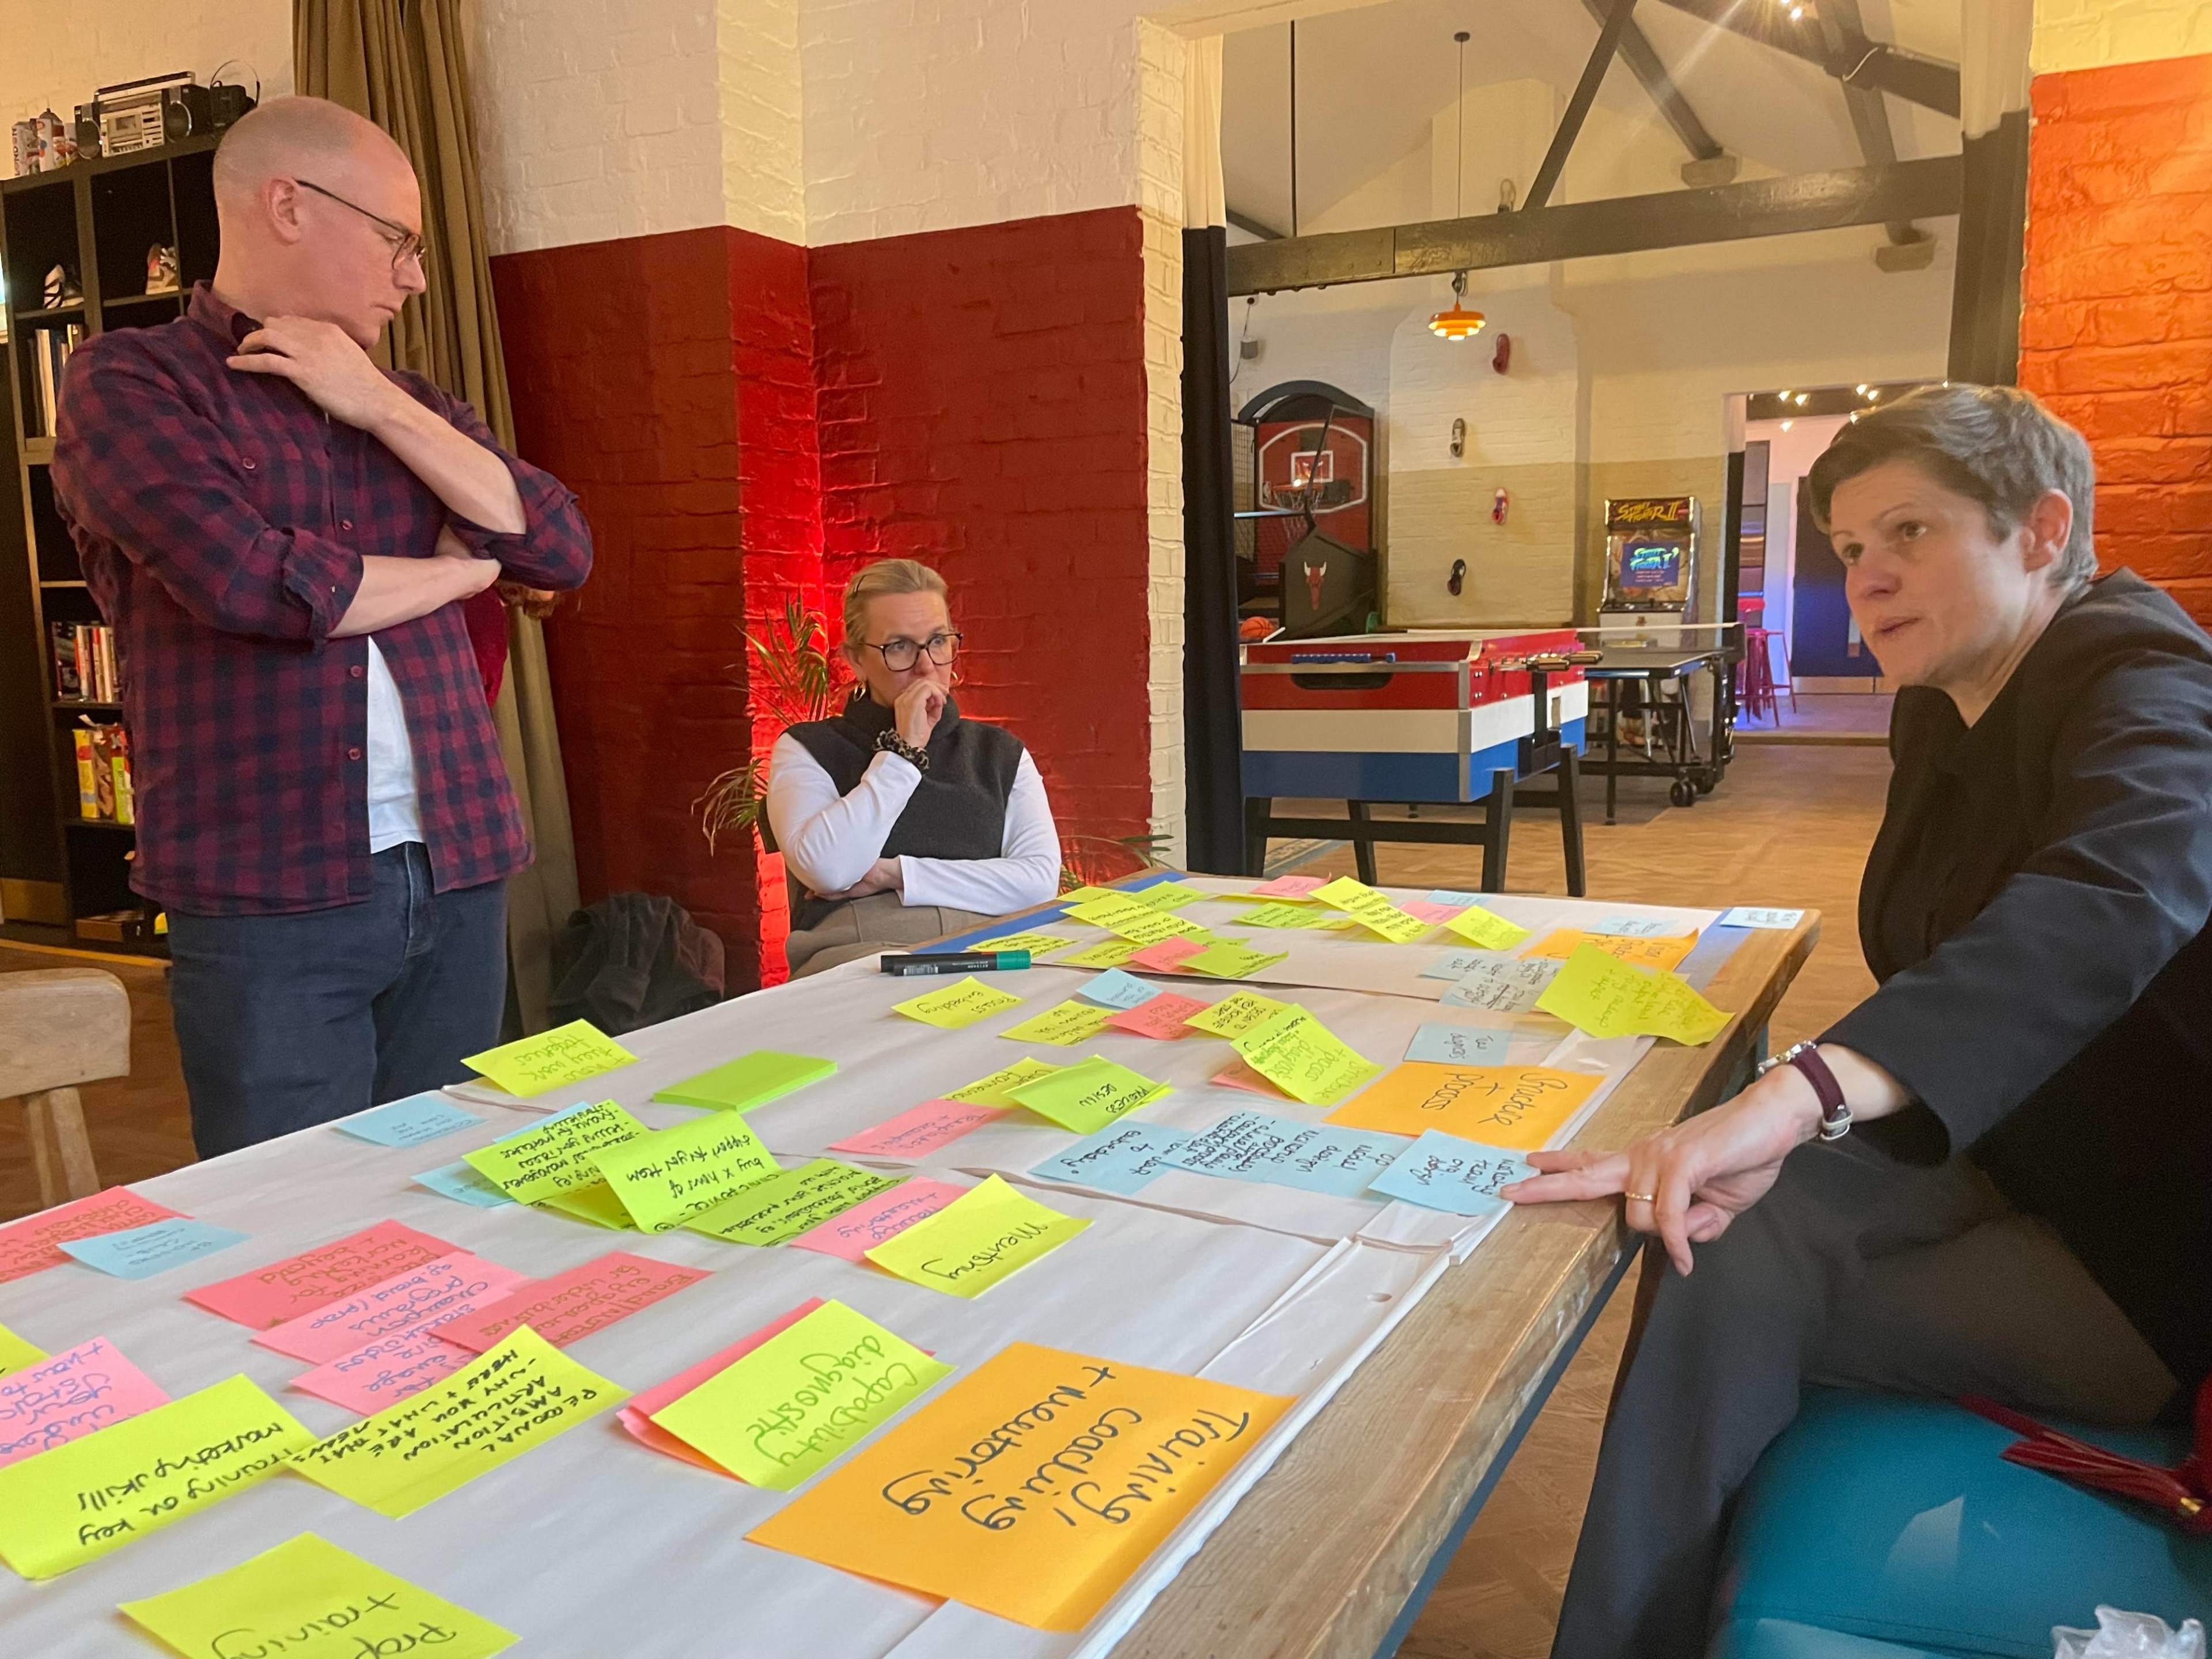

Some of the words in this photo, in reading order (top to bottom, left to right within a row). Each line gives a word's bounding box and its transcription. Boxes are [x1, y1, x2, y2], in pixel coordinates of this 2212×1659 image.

[466, 1349, 518, 1389] HERE
[746, 1335, 884, 1436] diagnostic
[373, 1401, 438, 1438] WHAT
[403, 1376, 546, 1461] ARTICULATION
[432, 1399, 476, 1423] YOU
[453, 1386, 562, 1449] AMBITION
[754, 1363, 918, 1467] Capability
[155, 1422, 284, 1479] marketing
[318, 1435, 370, 1464] THAT
[369, 1427, 416, 1457] ARE
[882, 1386, 1086, 1516] mentoring
[961, 1408, 1142, 1531] coaching
[138, 1496, 179, 1516] on
[78, 1518, 135, 1546] key
